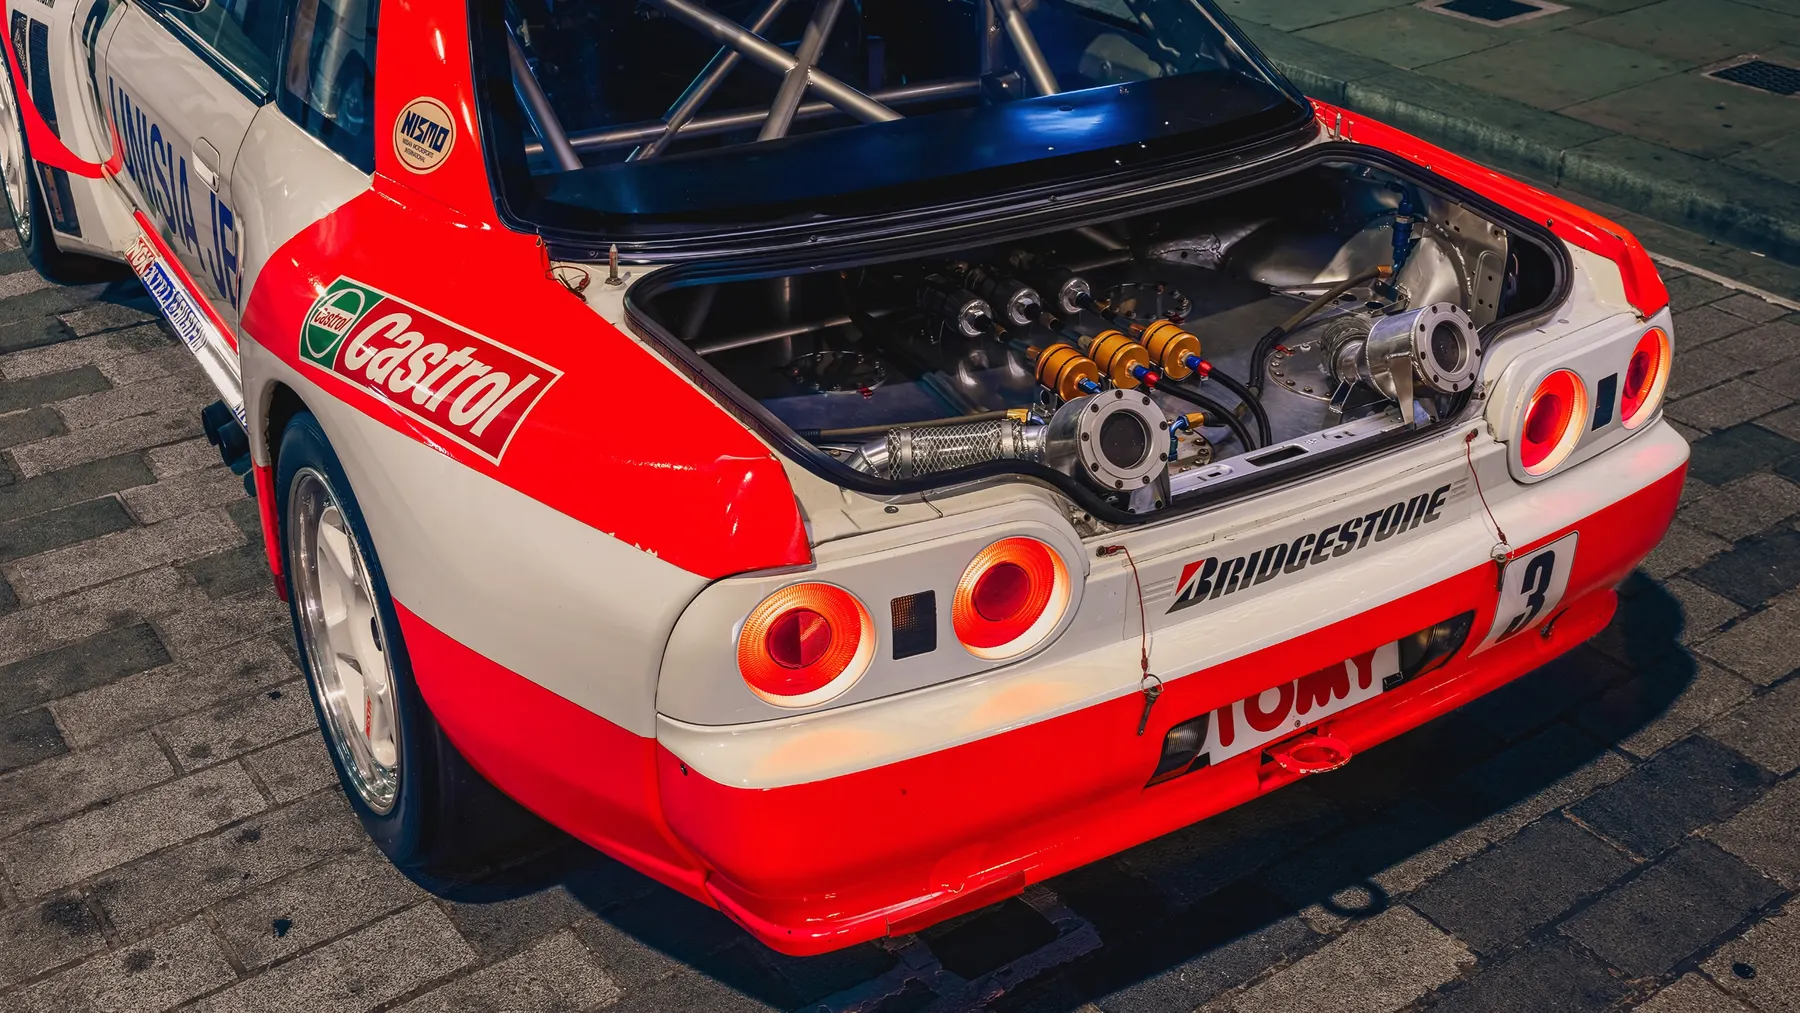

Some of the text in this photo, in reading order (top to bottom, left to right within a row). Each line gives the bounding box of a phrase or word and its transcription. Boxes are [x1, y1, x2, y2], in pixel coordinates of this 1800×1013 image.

[109, 75, 207, 273] UNISIA
[401, 110, 449, 152] NISMO
[126, 239, 155, 276] NGK
[314, 308, 354, 332] Castrol
[344, 313, 540, 437] Castrol
[1165, 483, 1453, 614] BRIDGESTONE
[1495, 550, 1555, 644] 3
[1217, 648, 1378, 747] TOMY
